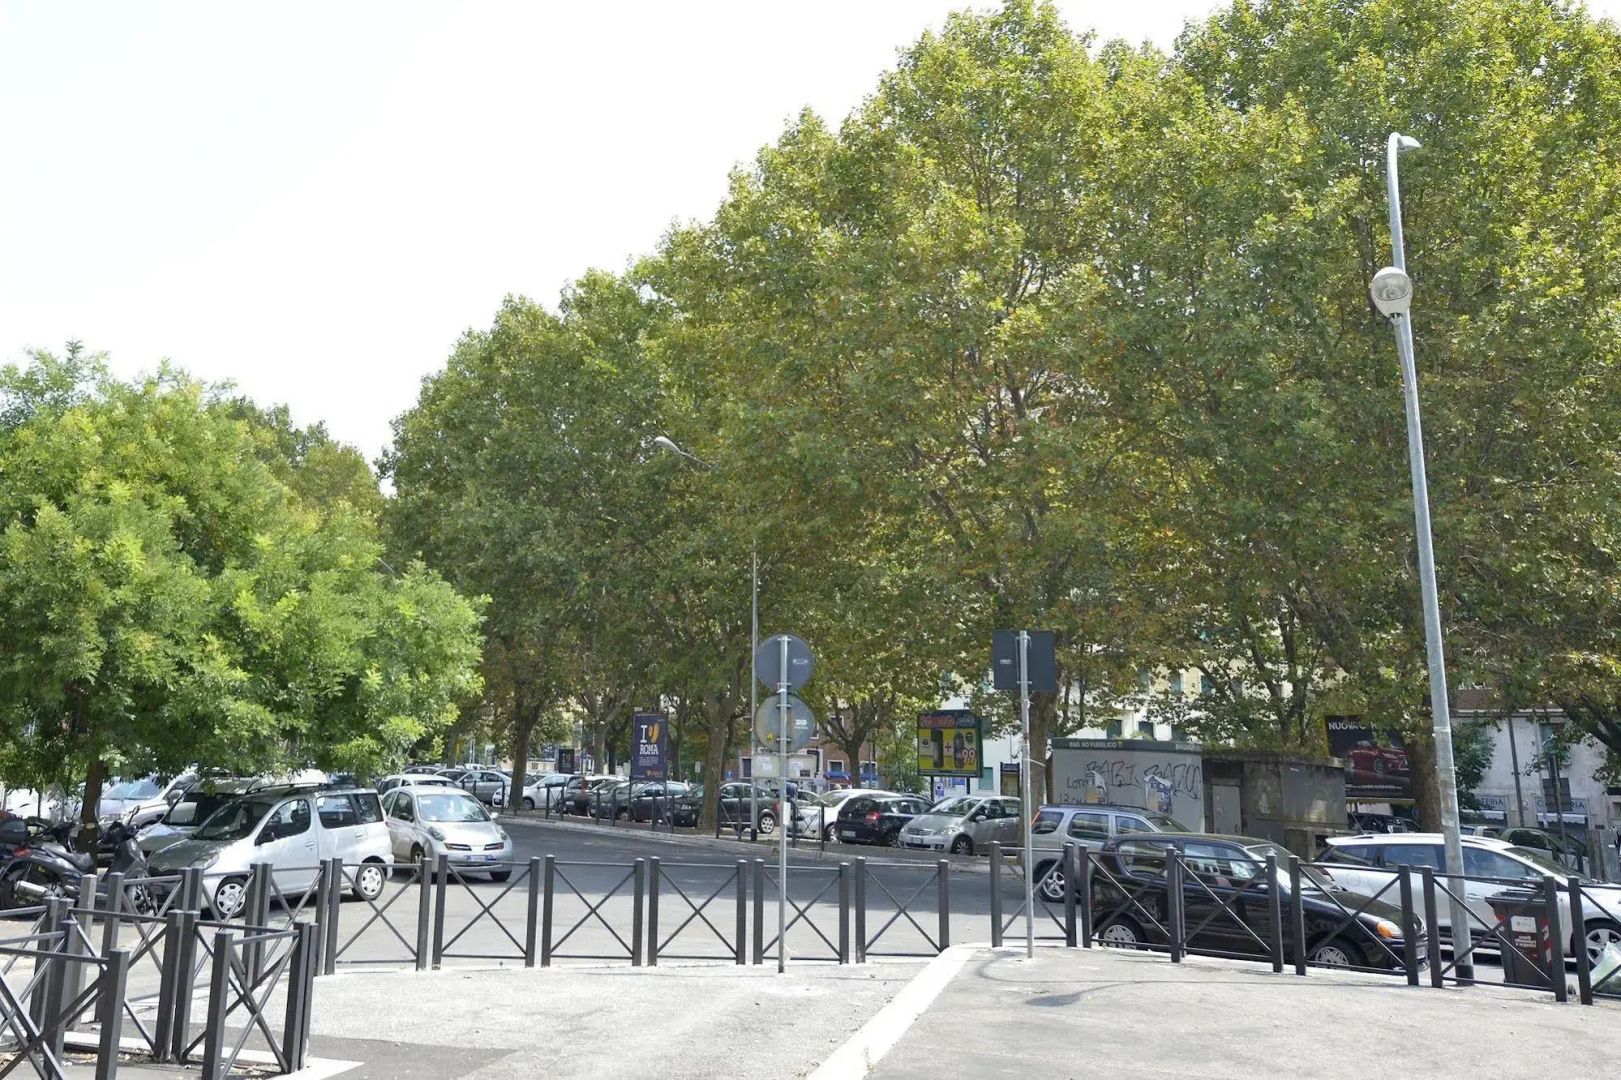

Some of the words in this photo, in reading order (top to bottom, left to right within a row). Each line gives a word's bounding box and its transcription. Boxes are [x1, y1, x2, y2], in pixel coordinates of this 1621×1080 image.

[1328, 722, 1358, 730] NUOVA
[640, 725, 647, 743] I
[639, 744, 659, 755] ROMA
[961, 748, 976, 765] 99
